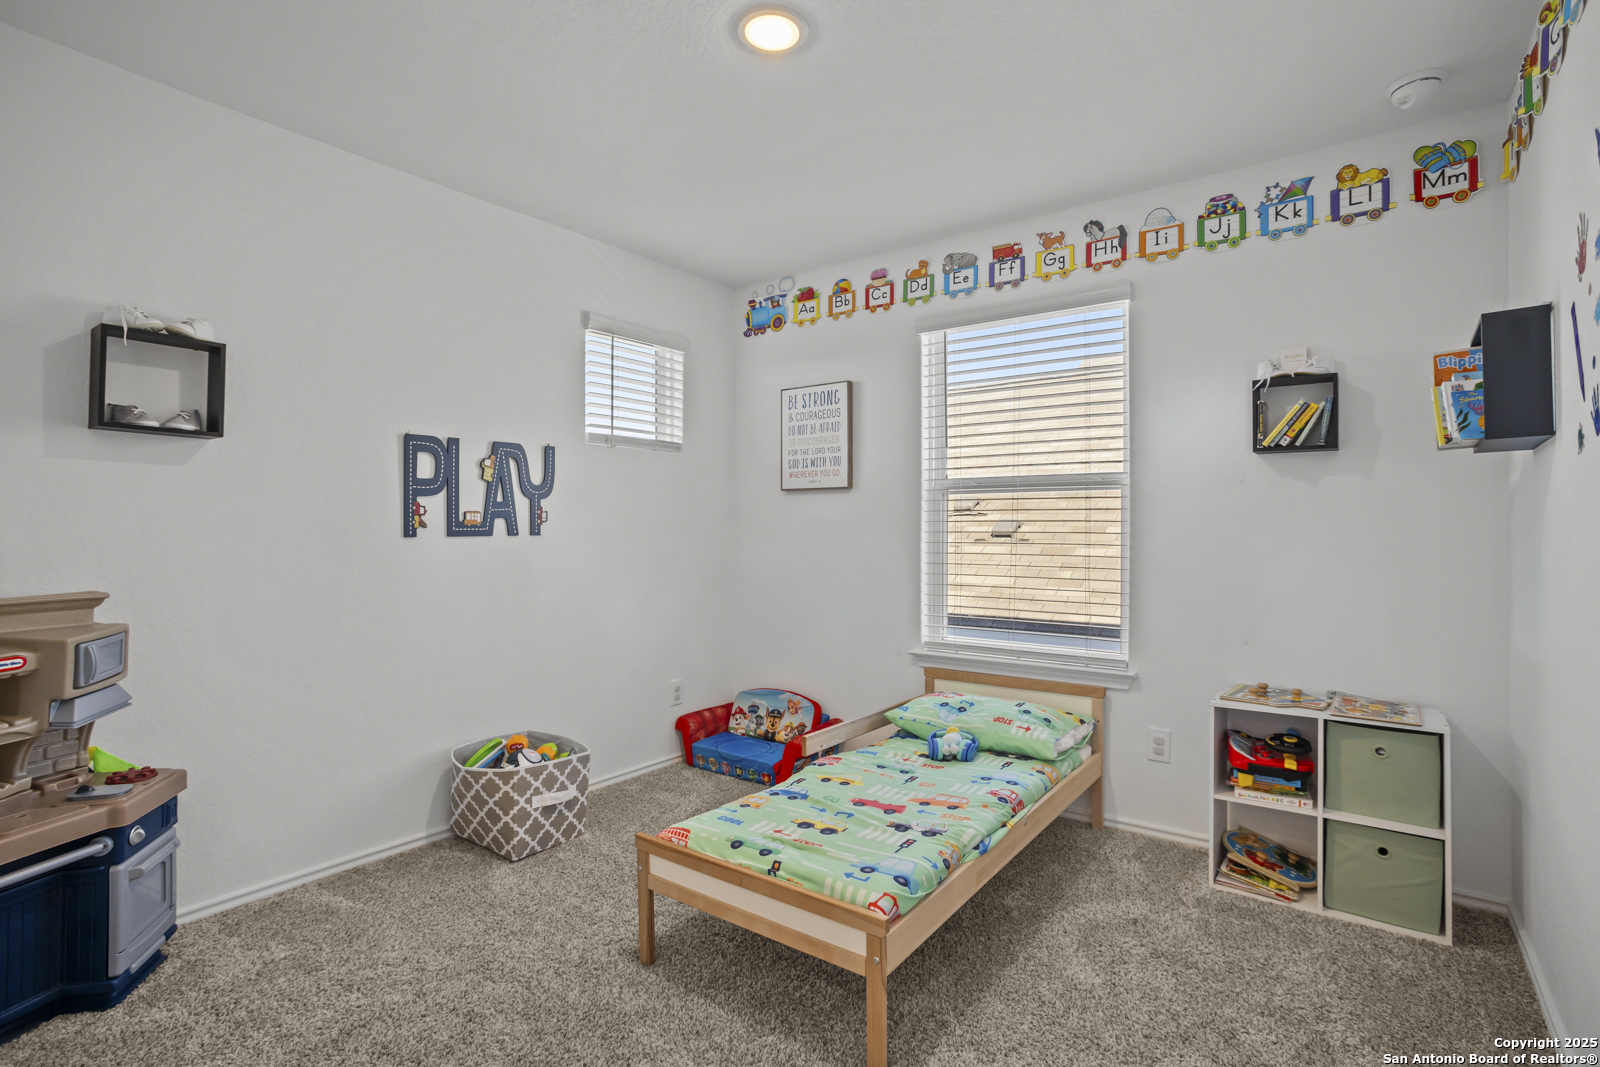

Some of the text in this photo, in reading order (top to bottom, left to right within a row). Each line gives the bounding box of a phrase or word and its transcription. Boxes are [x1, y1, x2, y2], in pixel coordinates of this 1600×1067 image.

[1422, 169, 1467, 189] Mm
[1275, 202, 1302, 222] Kk
[1209, 218, 1232, 239] Jj
[1154, 230, 1168, 246] Ii
[1094, 242, 1119, 257] Hh
[999, 261, 1016, 276] Ff
[1043, 253, 1066, 270] Gg
[953, 271, 969, 285] Ee
[909, 280, 928, 293] Dd
[871, 287, 888, 301] Cc
[834, 295, 850, 309] Bb
[799, 303, 815, 316] Aa
[1436, 352, 1483, 371] Blippi
[788, 389, 840, 410] BE STRONG
[788, 407, 841, 423] & COURAGEOUS
[788, 421, 841, 437] DO NOT BE AFRAID
[788, 439, 796, 447] OR
[788, 446, 841, 457] FOR THE LORD YOUR
[788, 455, 841, 469] GOD IS WITH YOU
[788, 470, 818, 479] WHEREVER
[820, 469, 831, 477] YOU
[403, 433, 555, 537] PLAY
[992, 716, 1014, 726] STOP
[823, 795, 840, 803] GO
[717, 815, 745, 826] COOL
[939, 813, 971, 822] STOP
